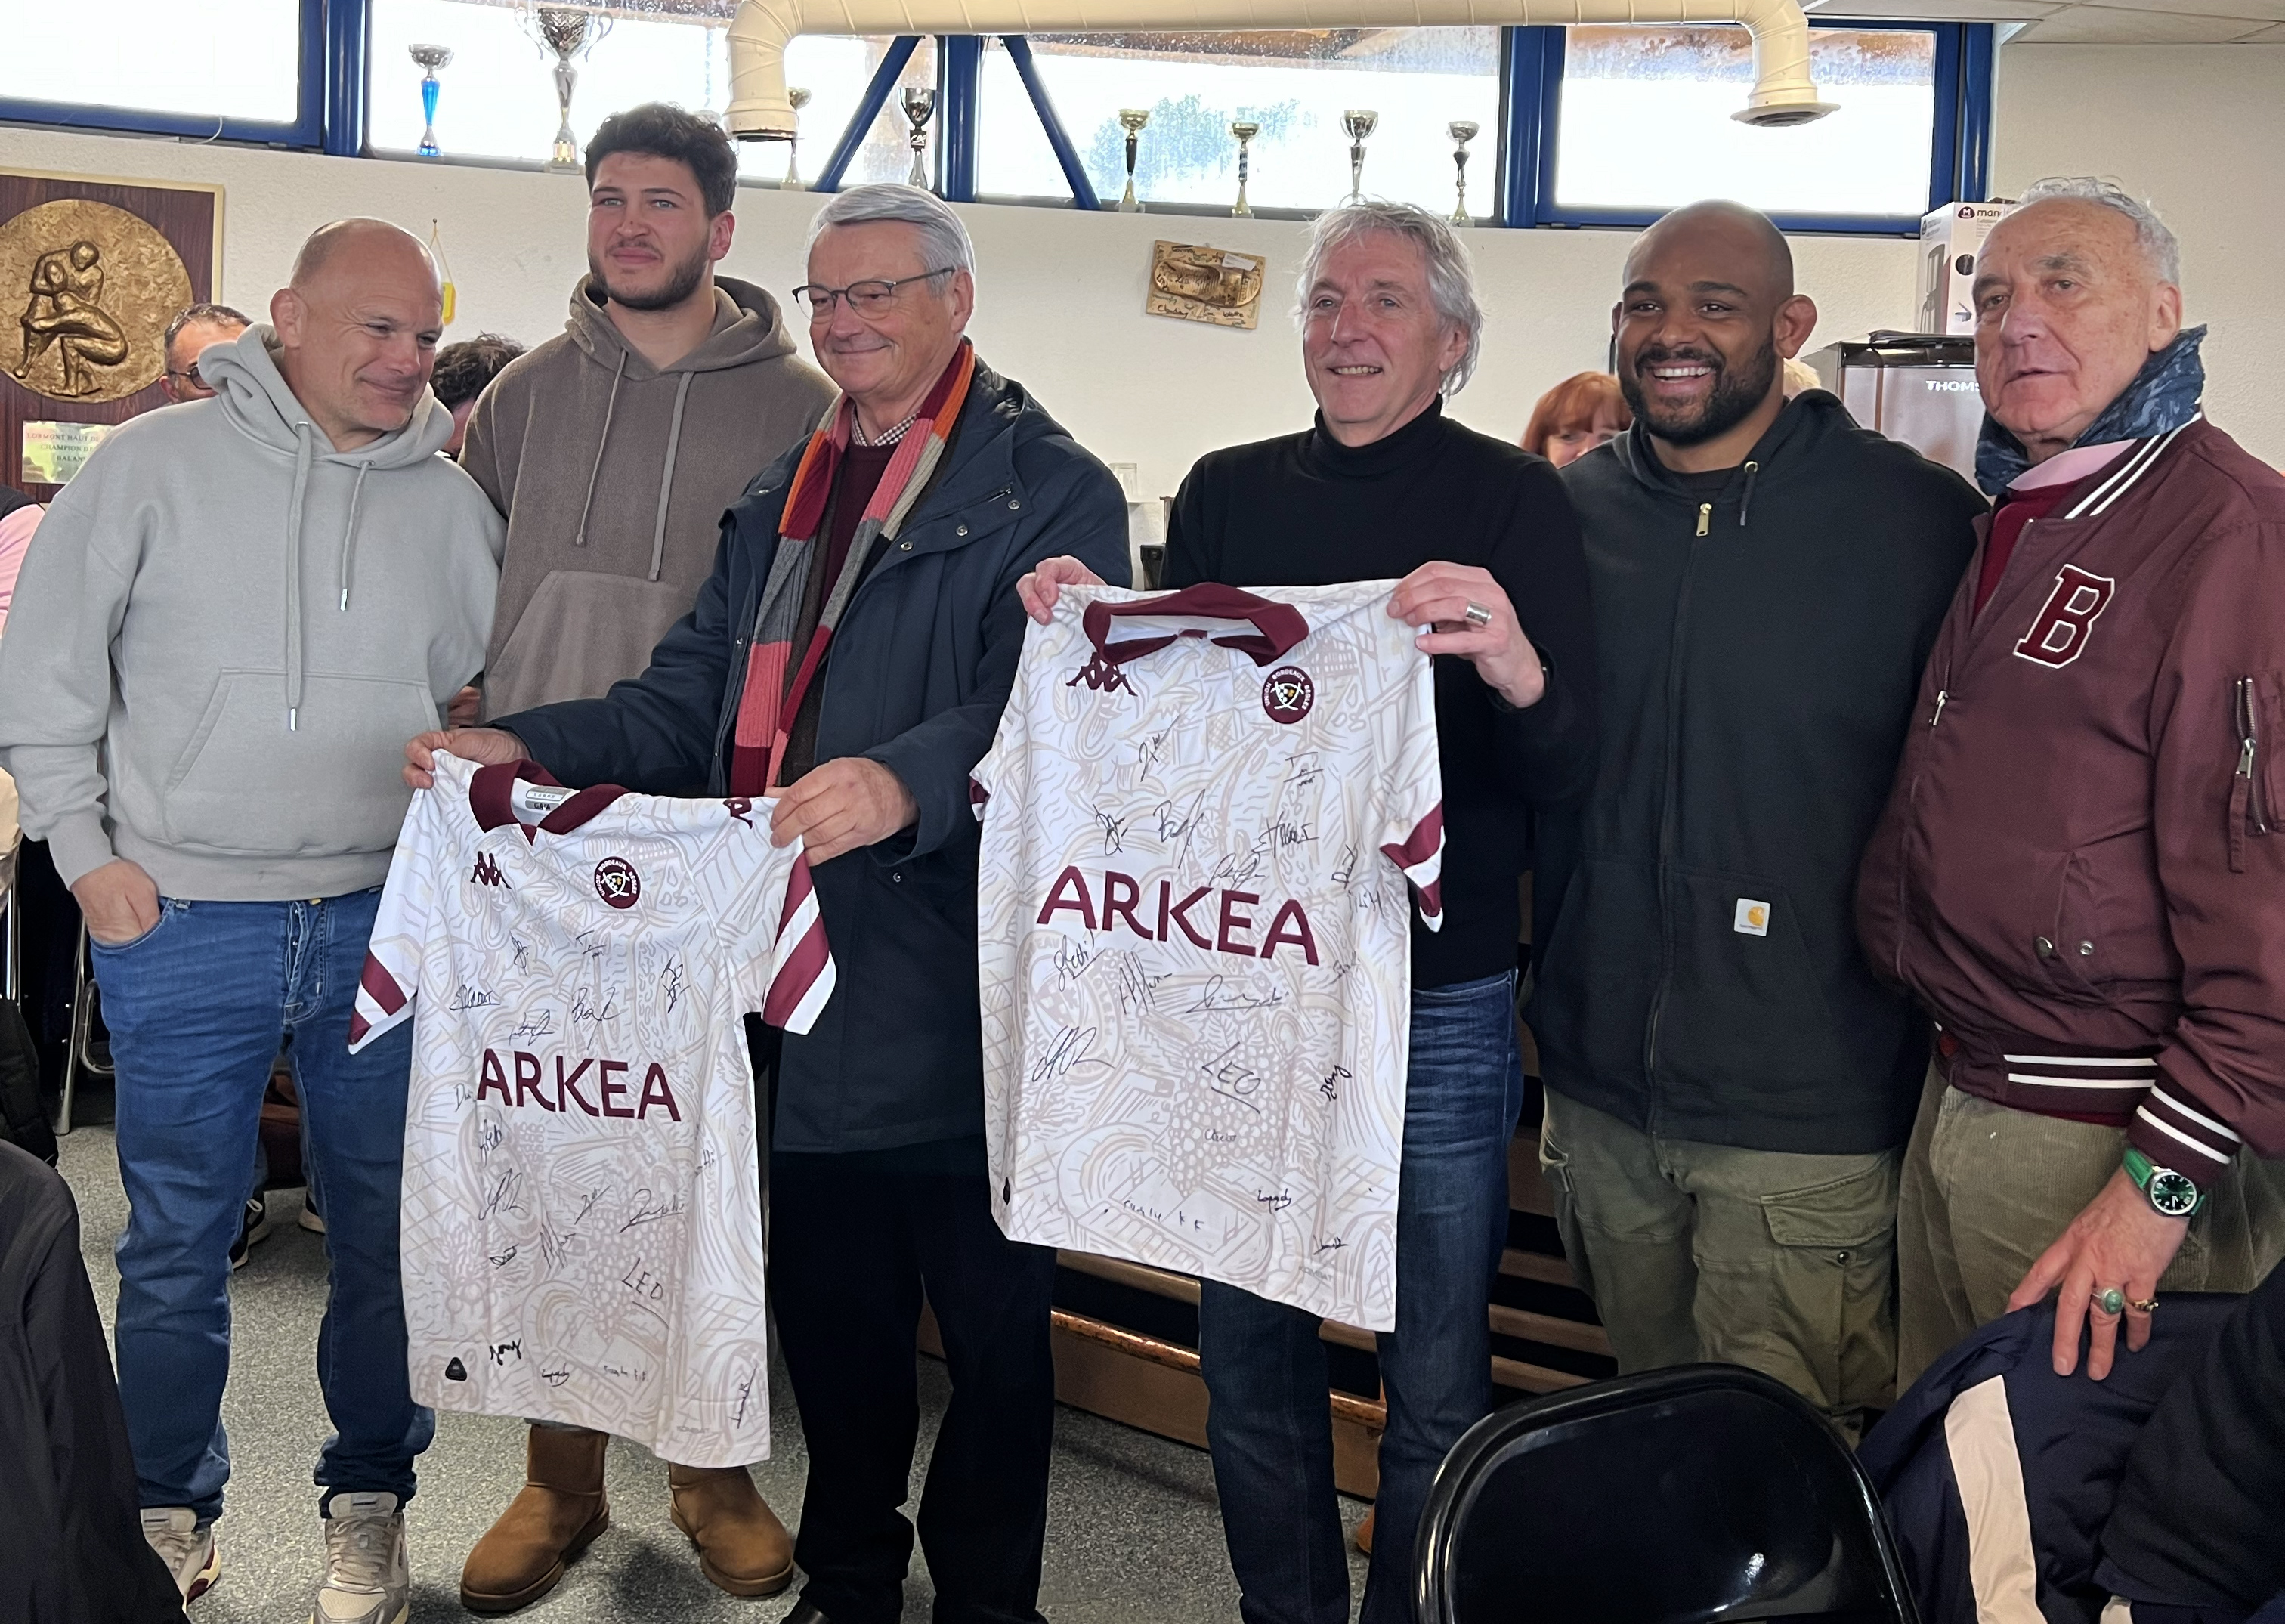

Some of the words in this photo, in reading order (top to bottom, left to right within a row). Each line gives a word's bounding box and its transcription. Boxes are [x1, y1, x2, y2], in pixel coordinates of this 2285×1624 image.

[41, 444, 82, 452] CHAMPION
[2013, 564, 2115, 669] B
[1272, 668, 1305, 682] BORDEAUX
[598, 859, 626, 871] BORDEAUX
[1036, 865, 1319, 967] ARKEA
[477, 1048, 682, 1122] ARKEA
[1201, 1041, 1261, 1095] LEO
[622, 1257, 664, 1301] LEO
